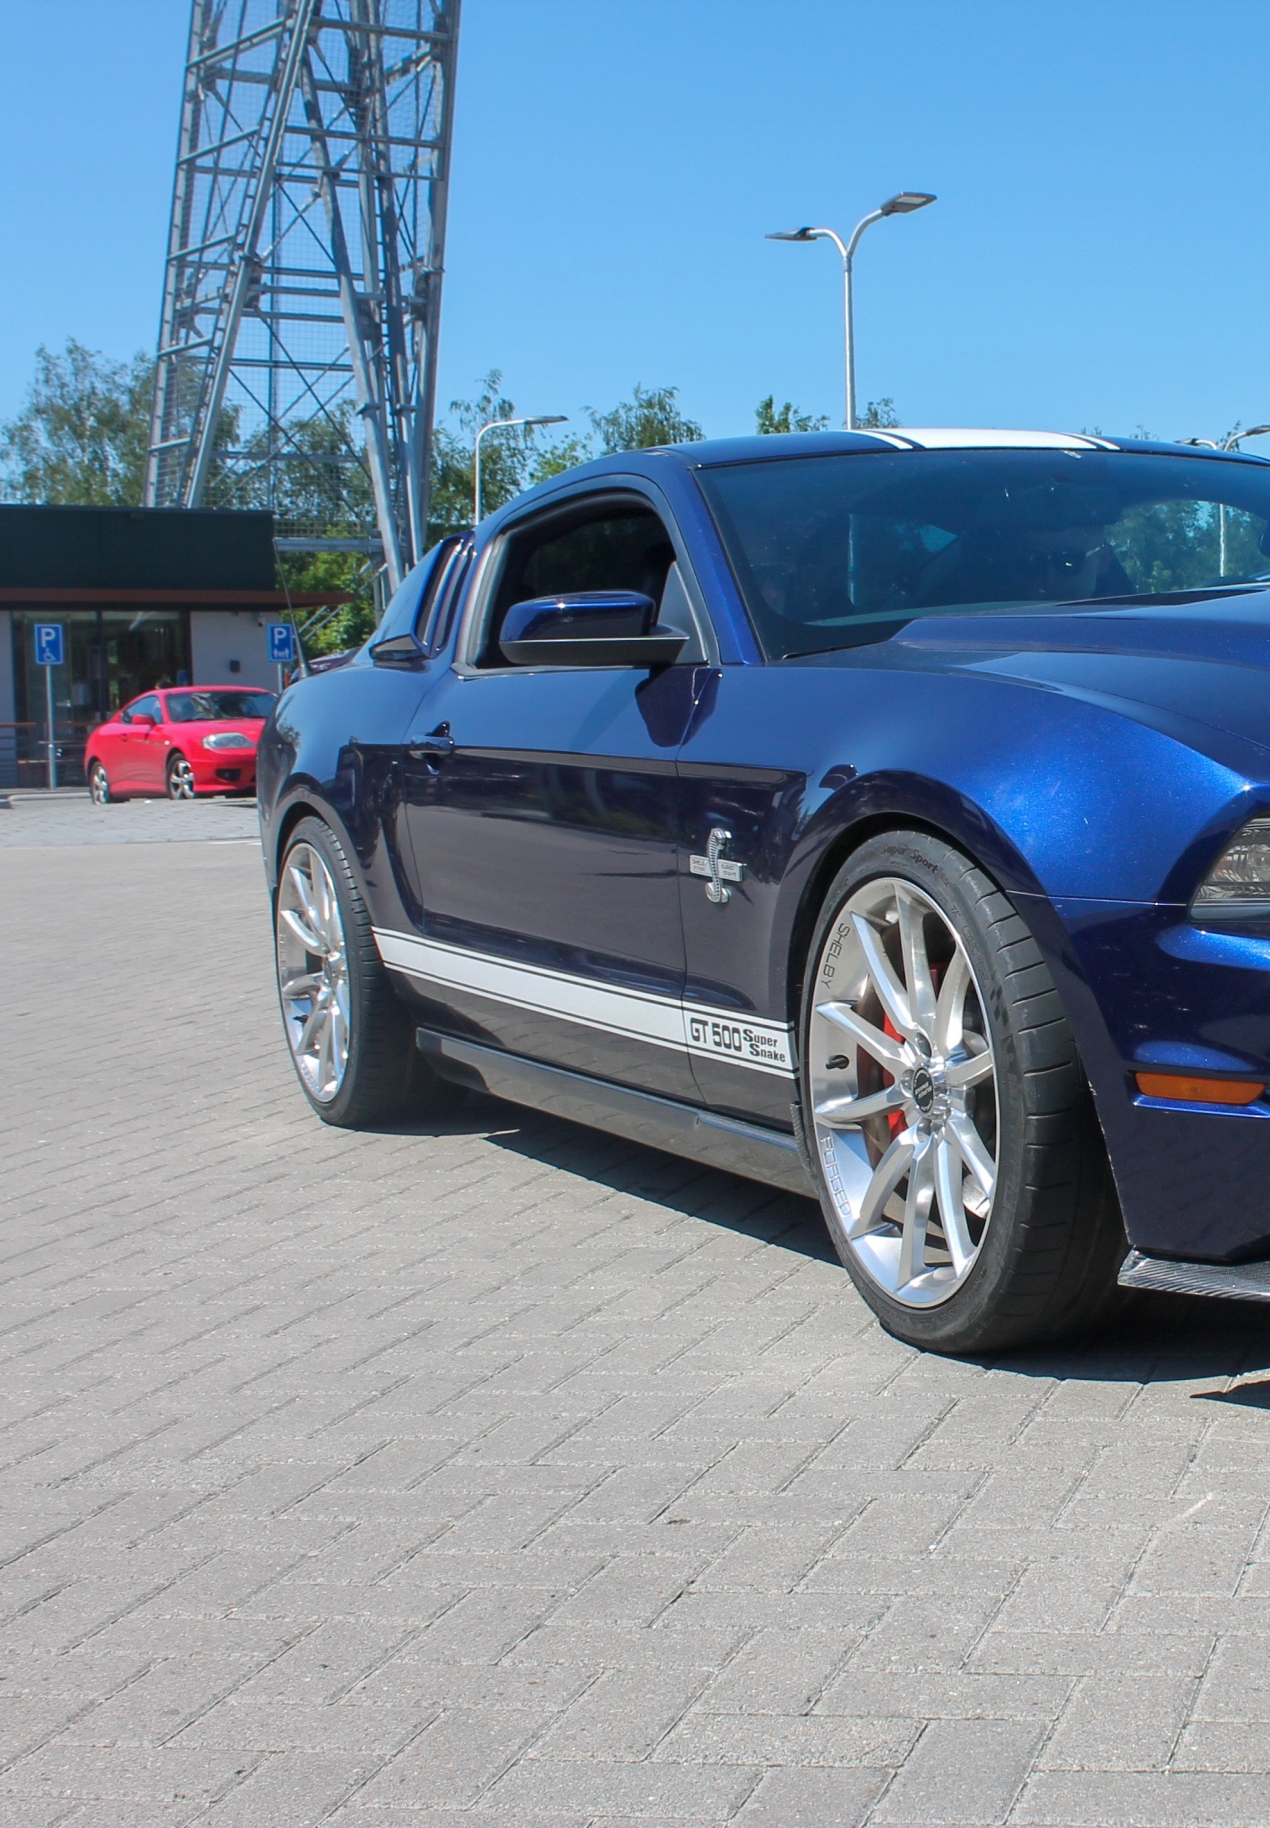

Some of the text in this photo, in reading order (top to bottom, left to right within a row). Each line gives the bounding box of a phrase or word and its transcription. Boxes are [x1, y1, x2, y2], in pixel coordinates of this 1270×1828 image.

[41, 628, 55, 648] P
[274, 627, 286, 644] P
[821, 922, 851, 989] SHELBY
[690, 1017, 742, 1052] GT 500
[743, 1028, 779, 1048] Super
[748, 1043, 786, 1063] Snake
